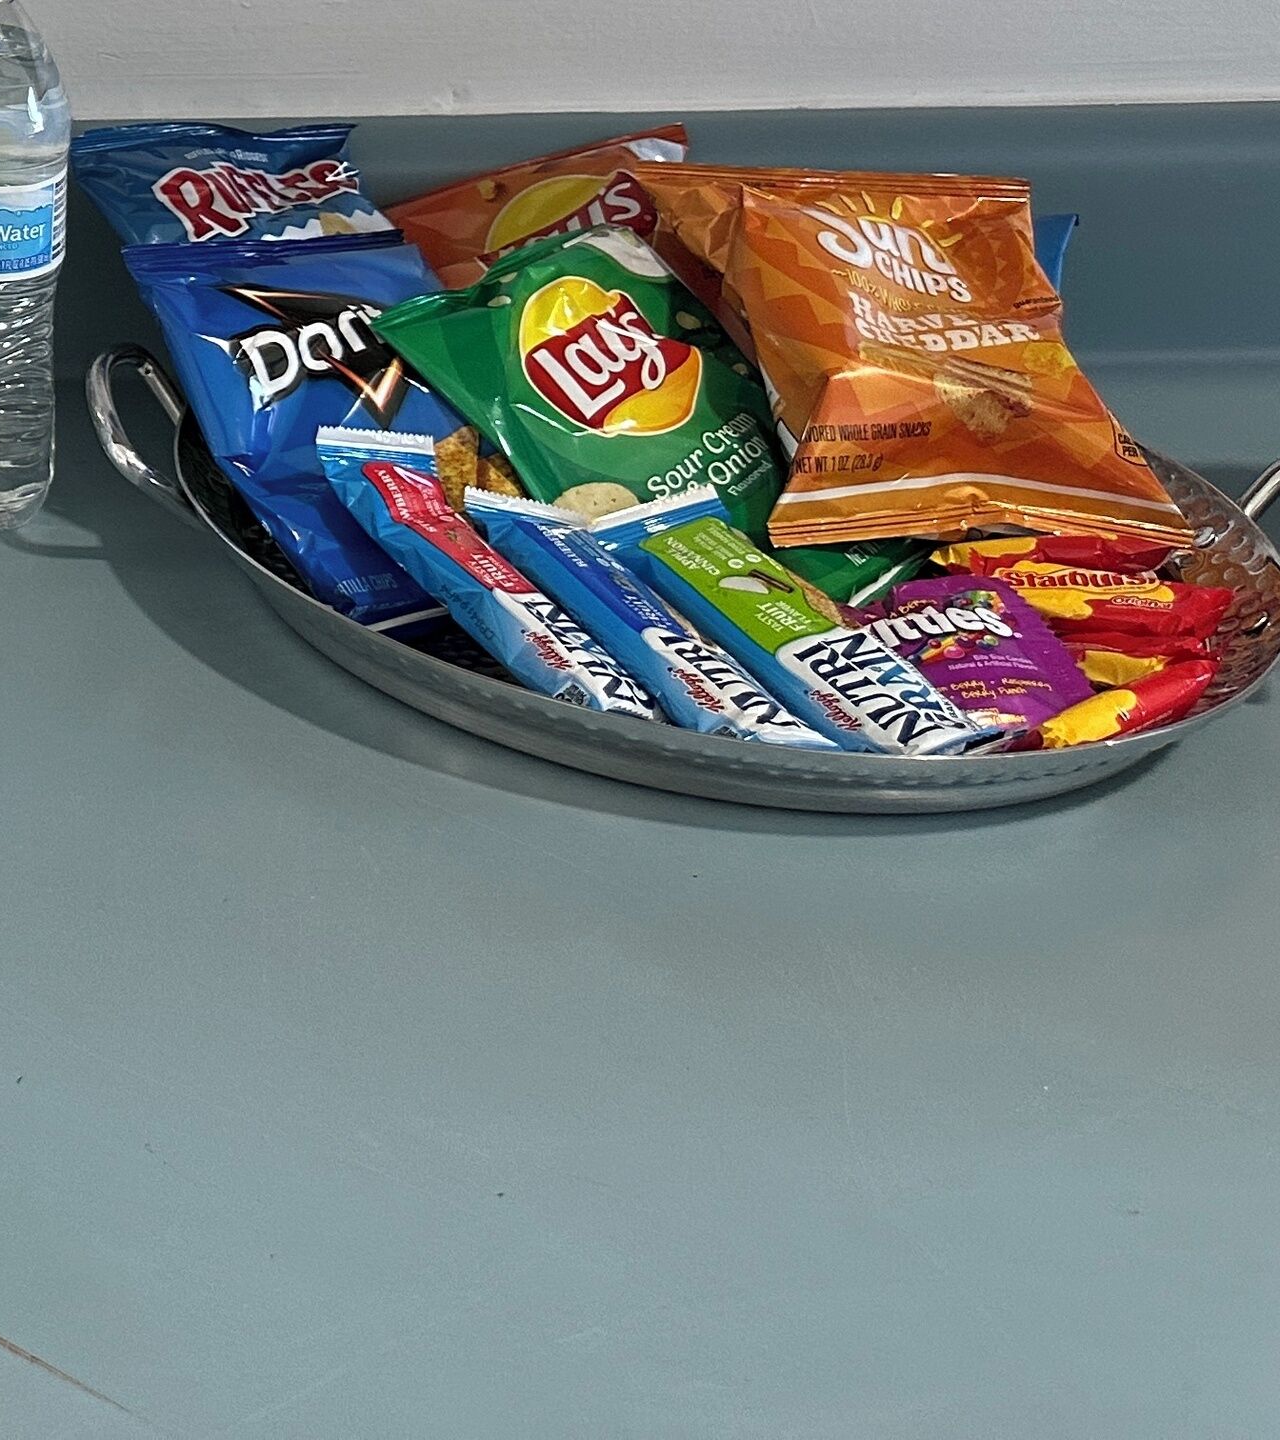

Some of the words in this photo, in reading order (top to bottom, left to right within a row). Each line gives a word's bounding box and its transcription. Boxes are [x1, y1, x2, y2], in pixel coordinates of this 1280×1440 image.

[152, 159, 360, 242] RUFFLES
[805, 208, 957, 275] Sun
[873, 251, 973, 303] CHIPS
[847, 291, 978, 335] HARVE
[855, 316, 1040, 353] CHEDDAR
[239, 303, 383, 400] Dori
[531, 307, 667, 420] Lay's
[838, 423, 870, 442] WHOLE
[871, 422, 897, 440] GRAIN
[899, 421, 932, 439] SNACKS
[646, 448, 703, 501] Sour
[701, 413, 758, 454] Cream
[707, 434, 769, 487] Onion
[795, 456, 813, 474] NET
[837, 454, 850, 471] OZ
[727, 462, 773, 497] Flavored
[470, 552, 515, 589] FRUIT
[663, 535, 721, 577] CINNAMON
[755, 601, 804, 633] FRUIT
[755, 611, 782, 633] TASTY
[870, 605, 1014, 648] ittles
[524, 629, 574, 672] Kellogg's
[658, 635, 803, 729] NUTRI
[673, 667, 725, 713] Kellogg's
[792, 639, 945, 747] NUTRI
[809, 689, 863, 732] Kellogg's
